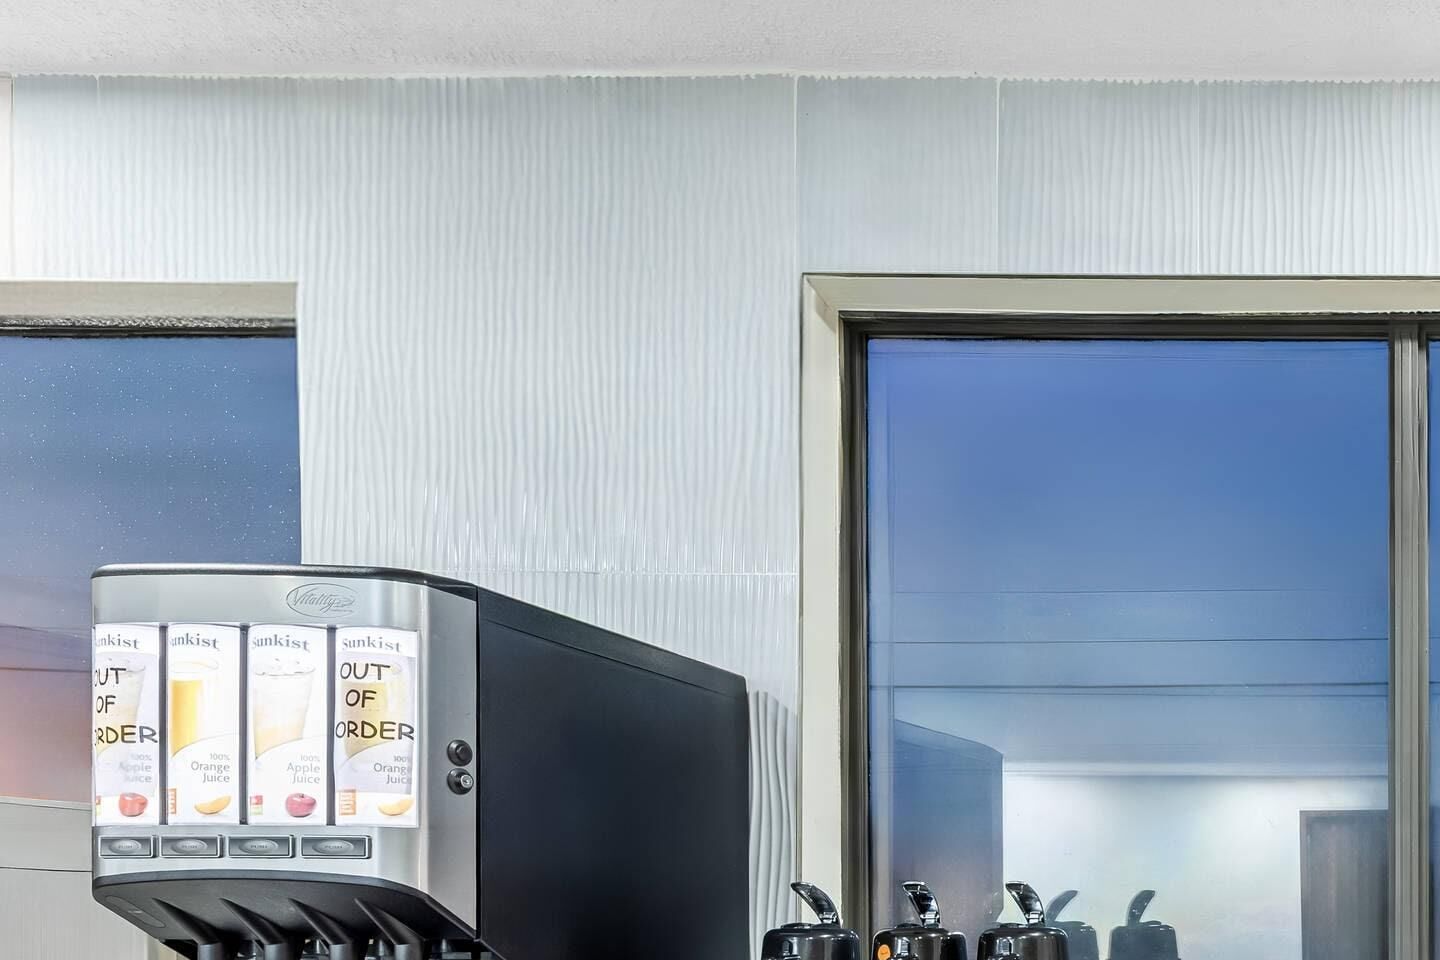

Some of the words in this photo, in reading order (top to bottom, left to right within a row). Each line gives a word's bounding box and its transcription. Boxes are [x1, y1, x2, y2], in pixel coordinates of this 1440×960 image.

[342, 635, 402, 653] Sunkist
[340, 661, 391, 681] OUT
[96, 694, 117, 714] OF
[345, 688, 377, 708] OF
[335, 720, 415, 741] ORDER
[190, 760, 231, 774] Orange
[286, 762, 321, 775] Apple
[202, 773, 231, 783] Juice
[292, 774, 321, 784] Juice
